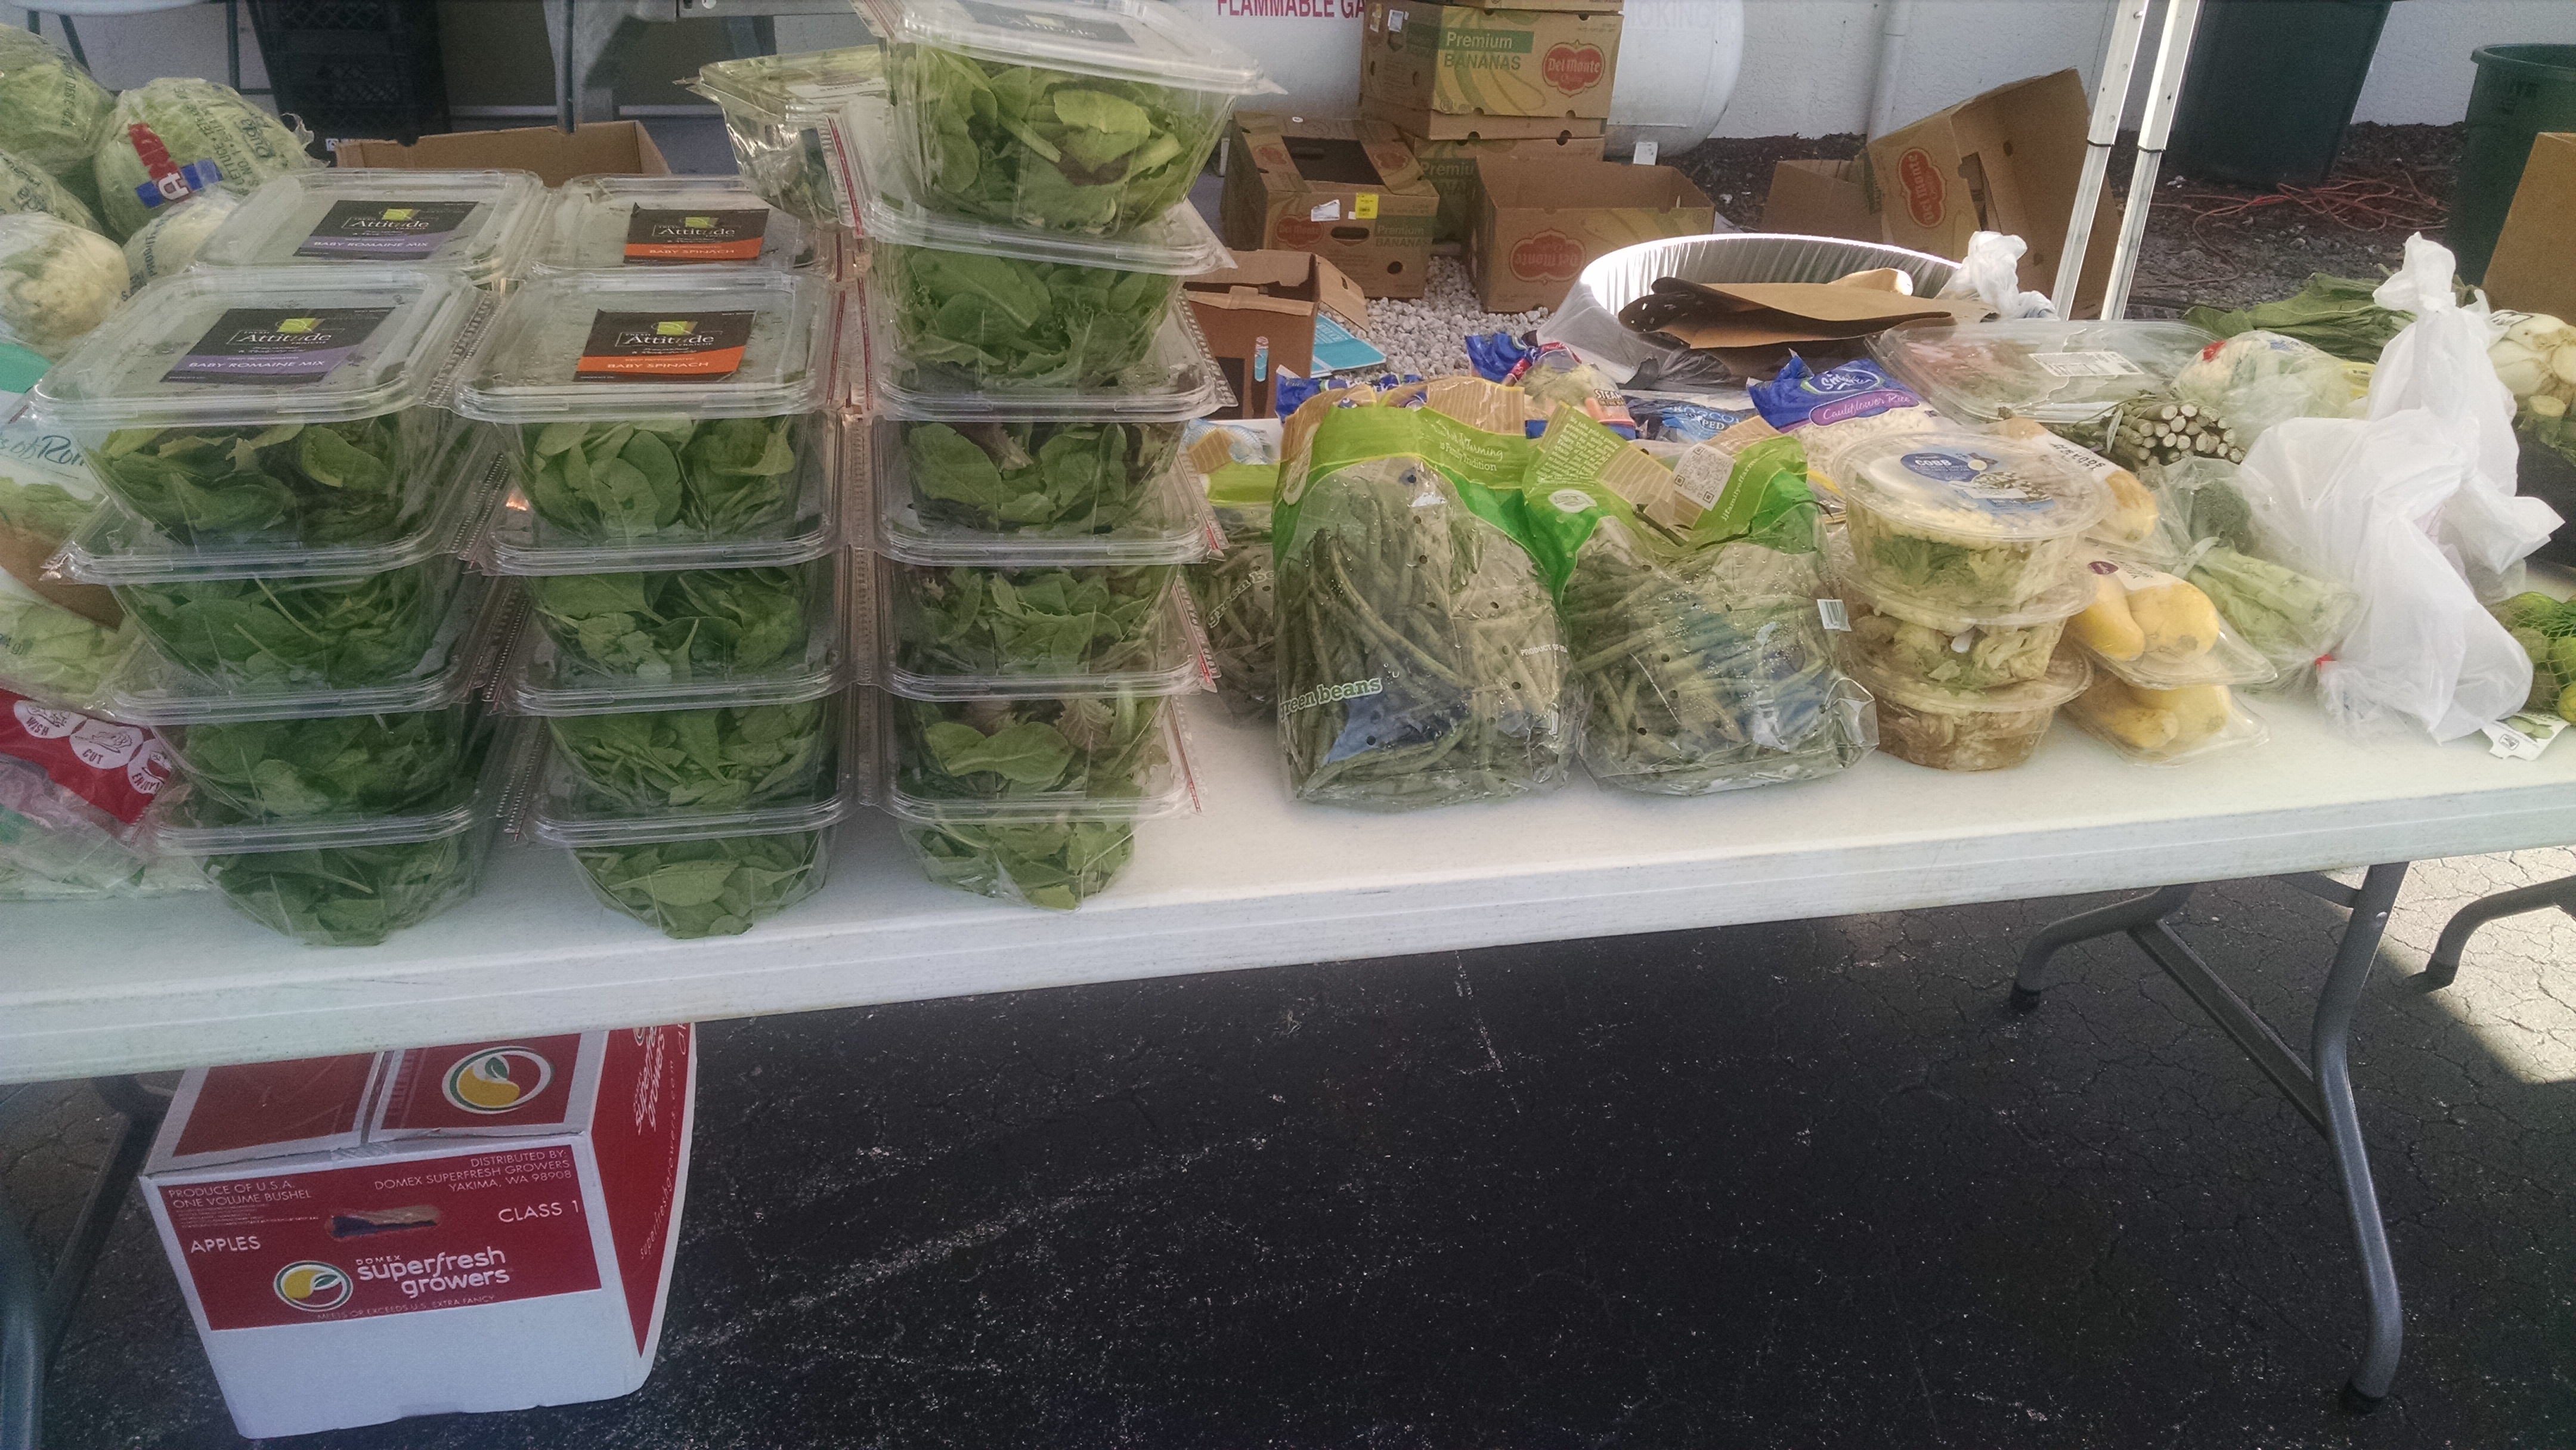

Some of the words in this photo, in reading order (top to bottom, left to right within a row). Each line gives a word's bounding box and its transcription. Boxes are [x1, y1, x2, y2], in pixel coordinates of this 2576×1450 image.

[1218, 0, 1335, 17] FLAMMABLE
[1341, 0, 1365, 18] GA
[1447, 32, 1512, 49] Premium
[1444, 52, 1521, 70] BANANAS
[1548, 58, 1564, 72] Del
[1566, 58, 1601, 73] Monte
[1420, 161, 1475, 176] Premiu
[1377, 225, 1425, 236] Premium
[1594, 389, 1623, 401] STEAM
[1822, 398, 1885, 420] Cauliflower
[1887, 393, 1911, 403] Rice
[1464, 438, 1503, 461] Farming
[1915, 458, 1952, 467] COBB
[1206, 579, 1252, 629] green
[1521, 645, 1552, 656] PRODUCT
[1317, 677, 1383, 705] beans
[26, 717, 50, 736] WASH
[82, 748, 104, 765] CUT
[470, 1151, 546, 1167] DISTRIBUTED
[550, 1149, 567, 1159] BY:
[374, 1176, 423, 1191] DOMEX
[426, 1167, 501, 1184] SUPERFRESH
[504, 1159, 570, 1175] GROWERS
[448, 1179, 502, 1192] YAKIMA,
[505, 1175, 528, 1185] WA
[531, 1170, 572, 1182] 98908
[169, 1185, 231, 1198] PRODUCE
[234, 1183, 252, 1193] OF
[256, 1180, 296, 1192] U.S.A.
[173, 1198, 203, 1209] ONE
[206, 1194, 261, 1206] VOLUME
[265, 1189, 312, 1202] BUSHEL
[498, 1202, 562, 1223] CLASS
[571, 1200, 580, 1213] 1
[191, 1235, 261, 1253] APPLES
[355, 1254, 401, 1265] DOMEX
[357, 1245, 506, 1281] superfresh
[401, 1268, 510, 1299] growers
[367, 1305, 408, 1316] EXCEEDS
[431, 1298, 460, 1308] EXTRA
[462, 1294, 496, 1305] FANCY
